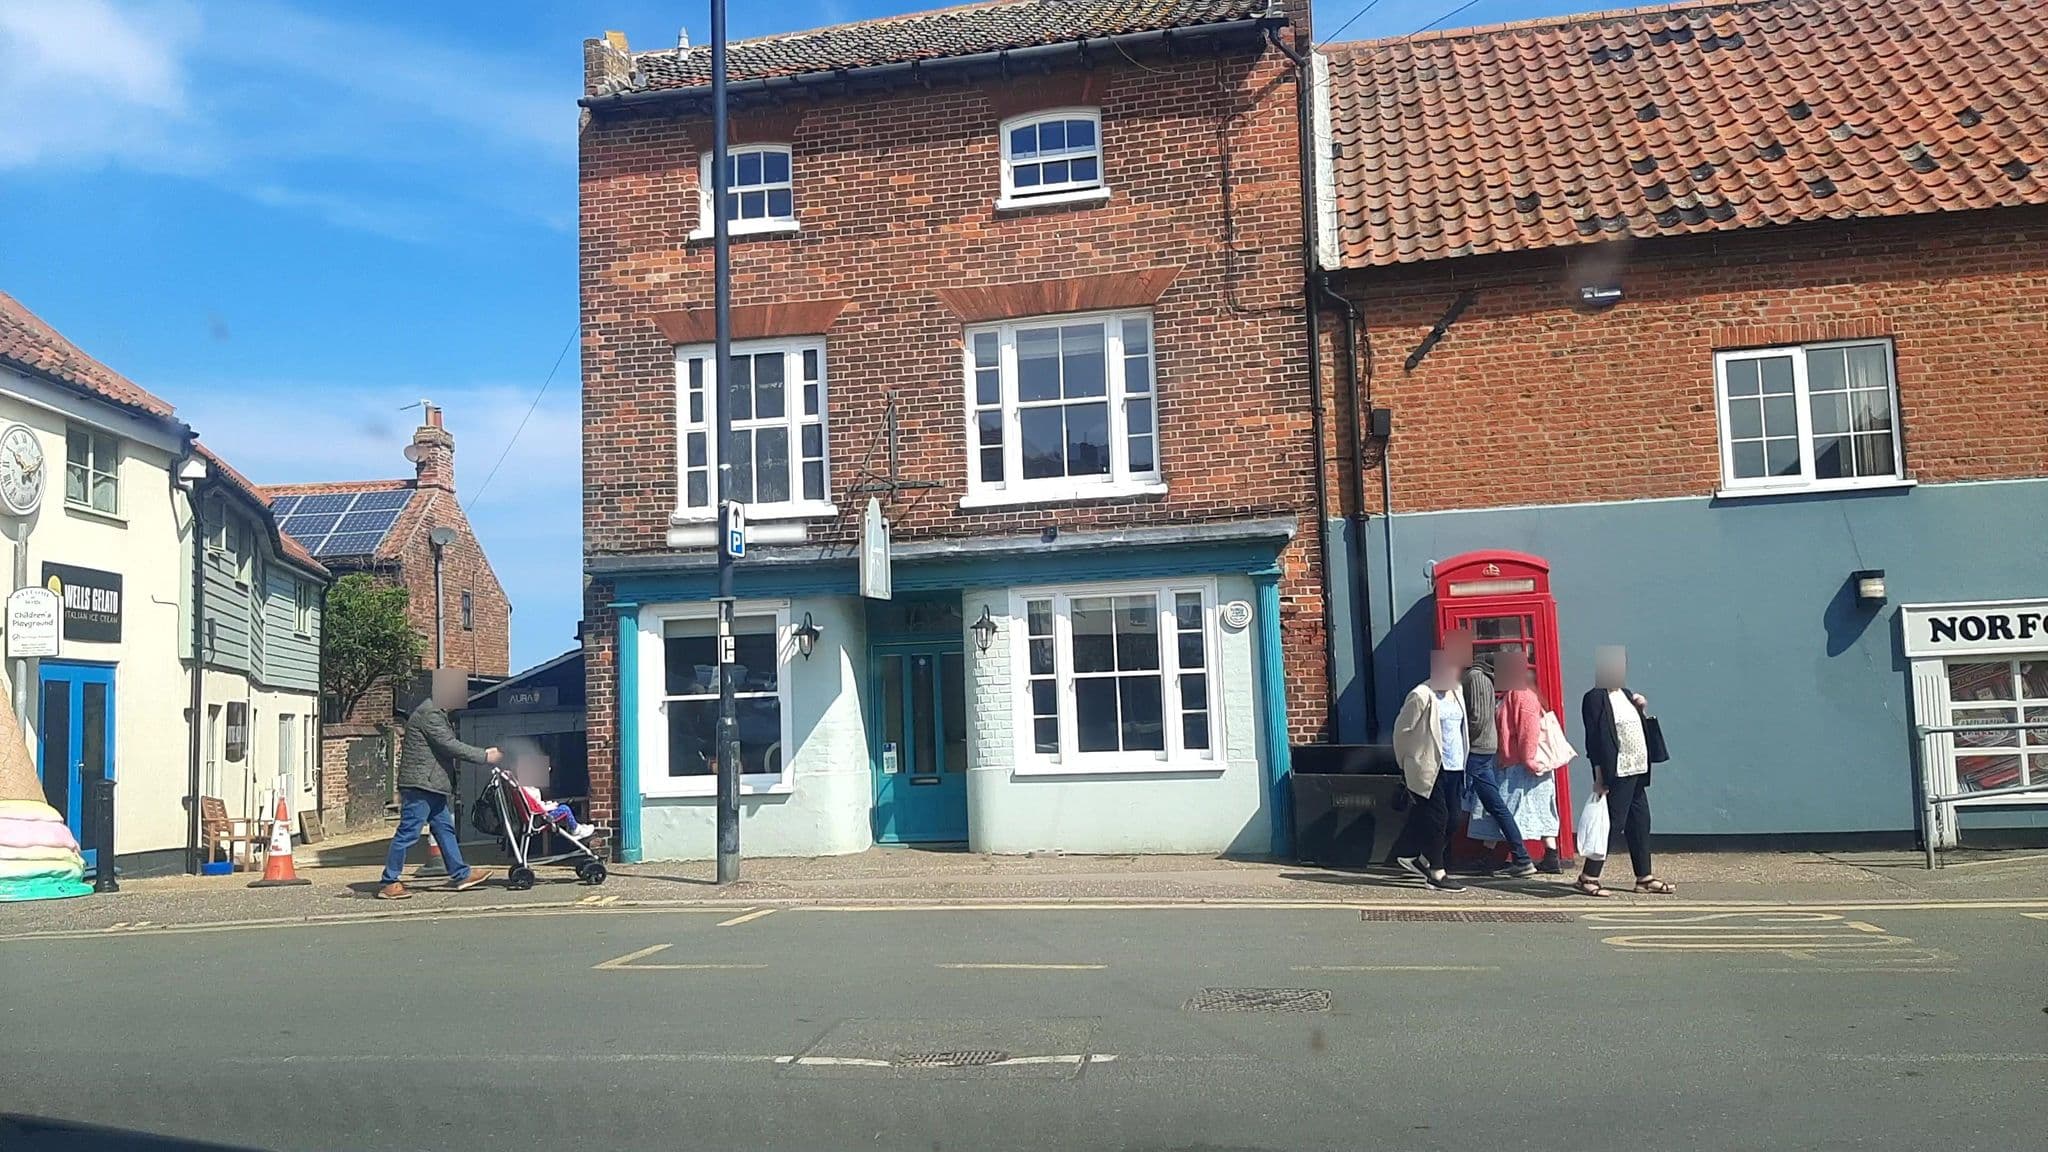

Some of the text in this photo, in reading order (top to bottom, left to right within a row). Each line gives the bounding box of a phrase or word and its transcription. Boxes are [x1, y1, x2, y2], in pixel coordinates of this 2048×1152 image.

[733, 534, 741, 551] P
[64, 584, 119, 614] WELLS GELATO
[1927, 613, 2048, 642] NORF
[509, 694, 534, 704] AURA
